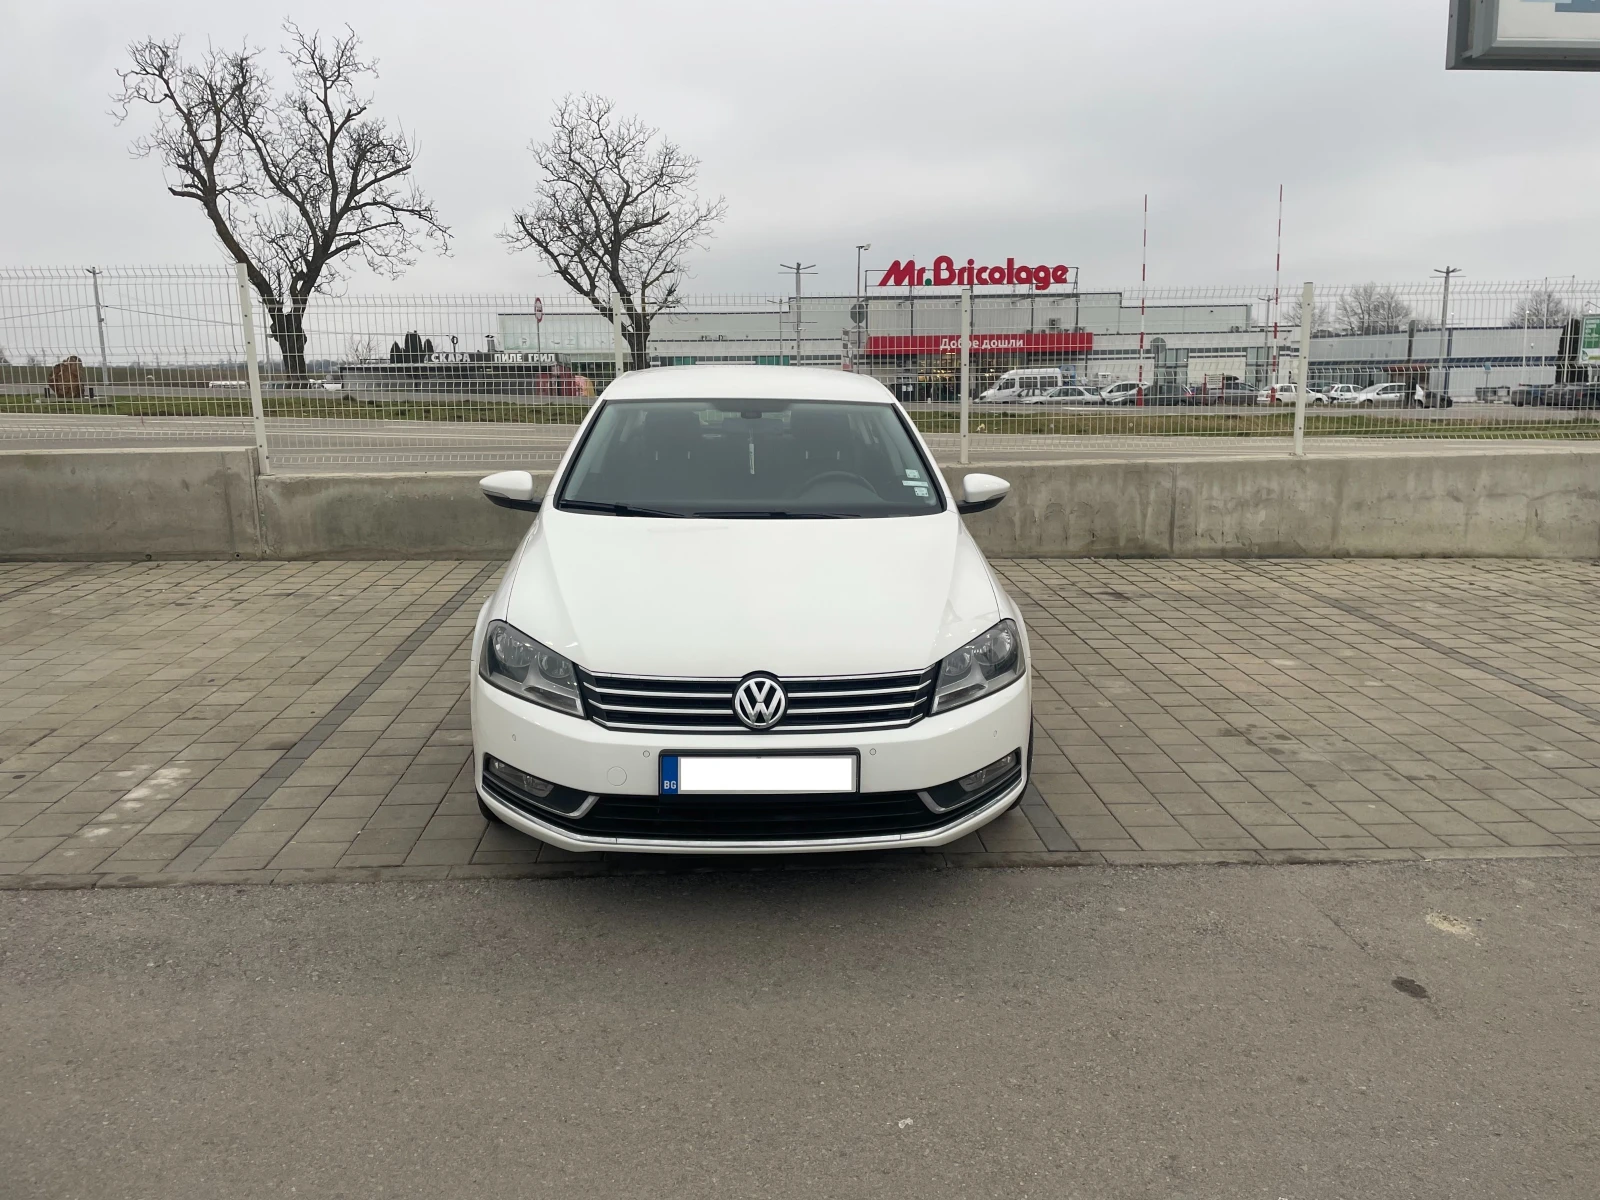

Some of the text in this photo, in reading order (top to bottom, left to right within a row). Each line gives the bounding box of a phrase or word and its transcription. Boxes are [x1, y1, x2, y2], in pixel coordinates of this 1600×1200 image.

[982, 339, 1024, 349] дошли
[431, 353, 556, 363] СКАРА ПИЛЕ ГРИЛ
[663, 780, 677, 790] BG
